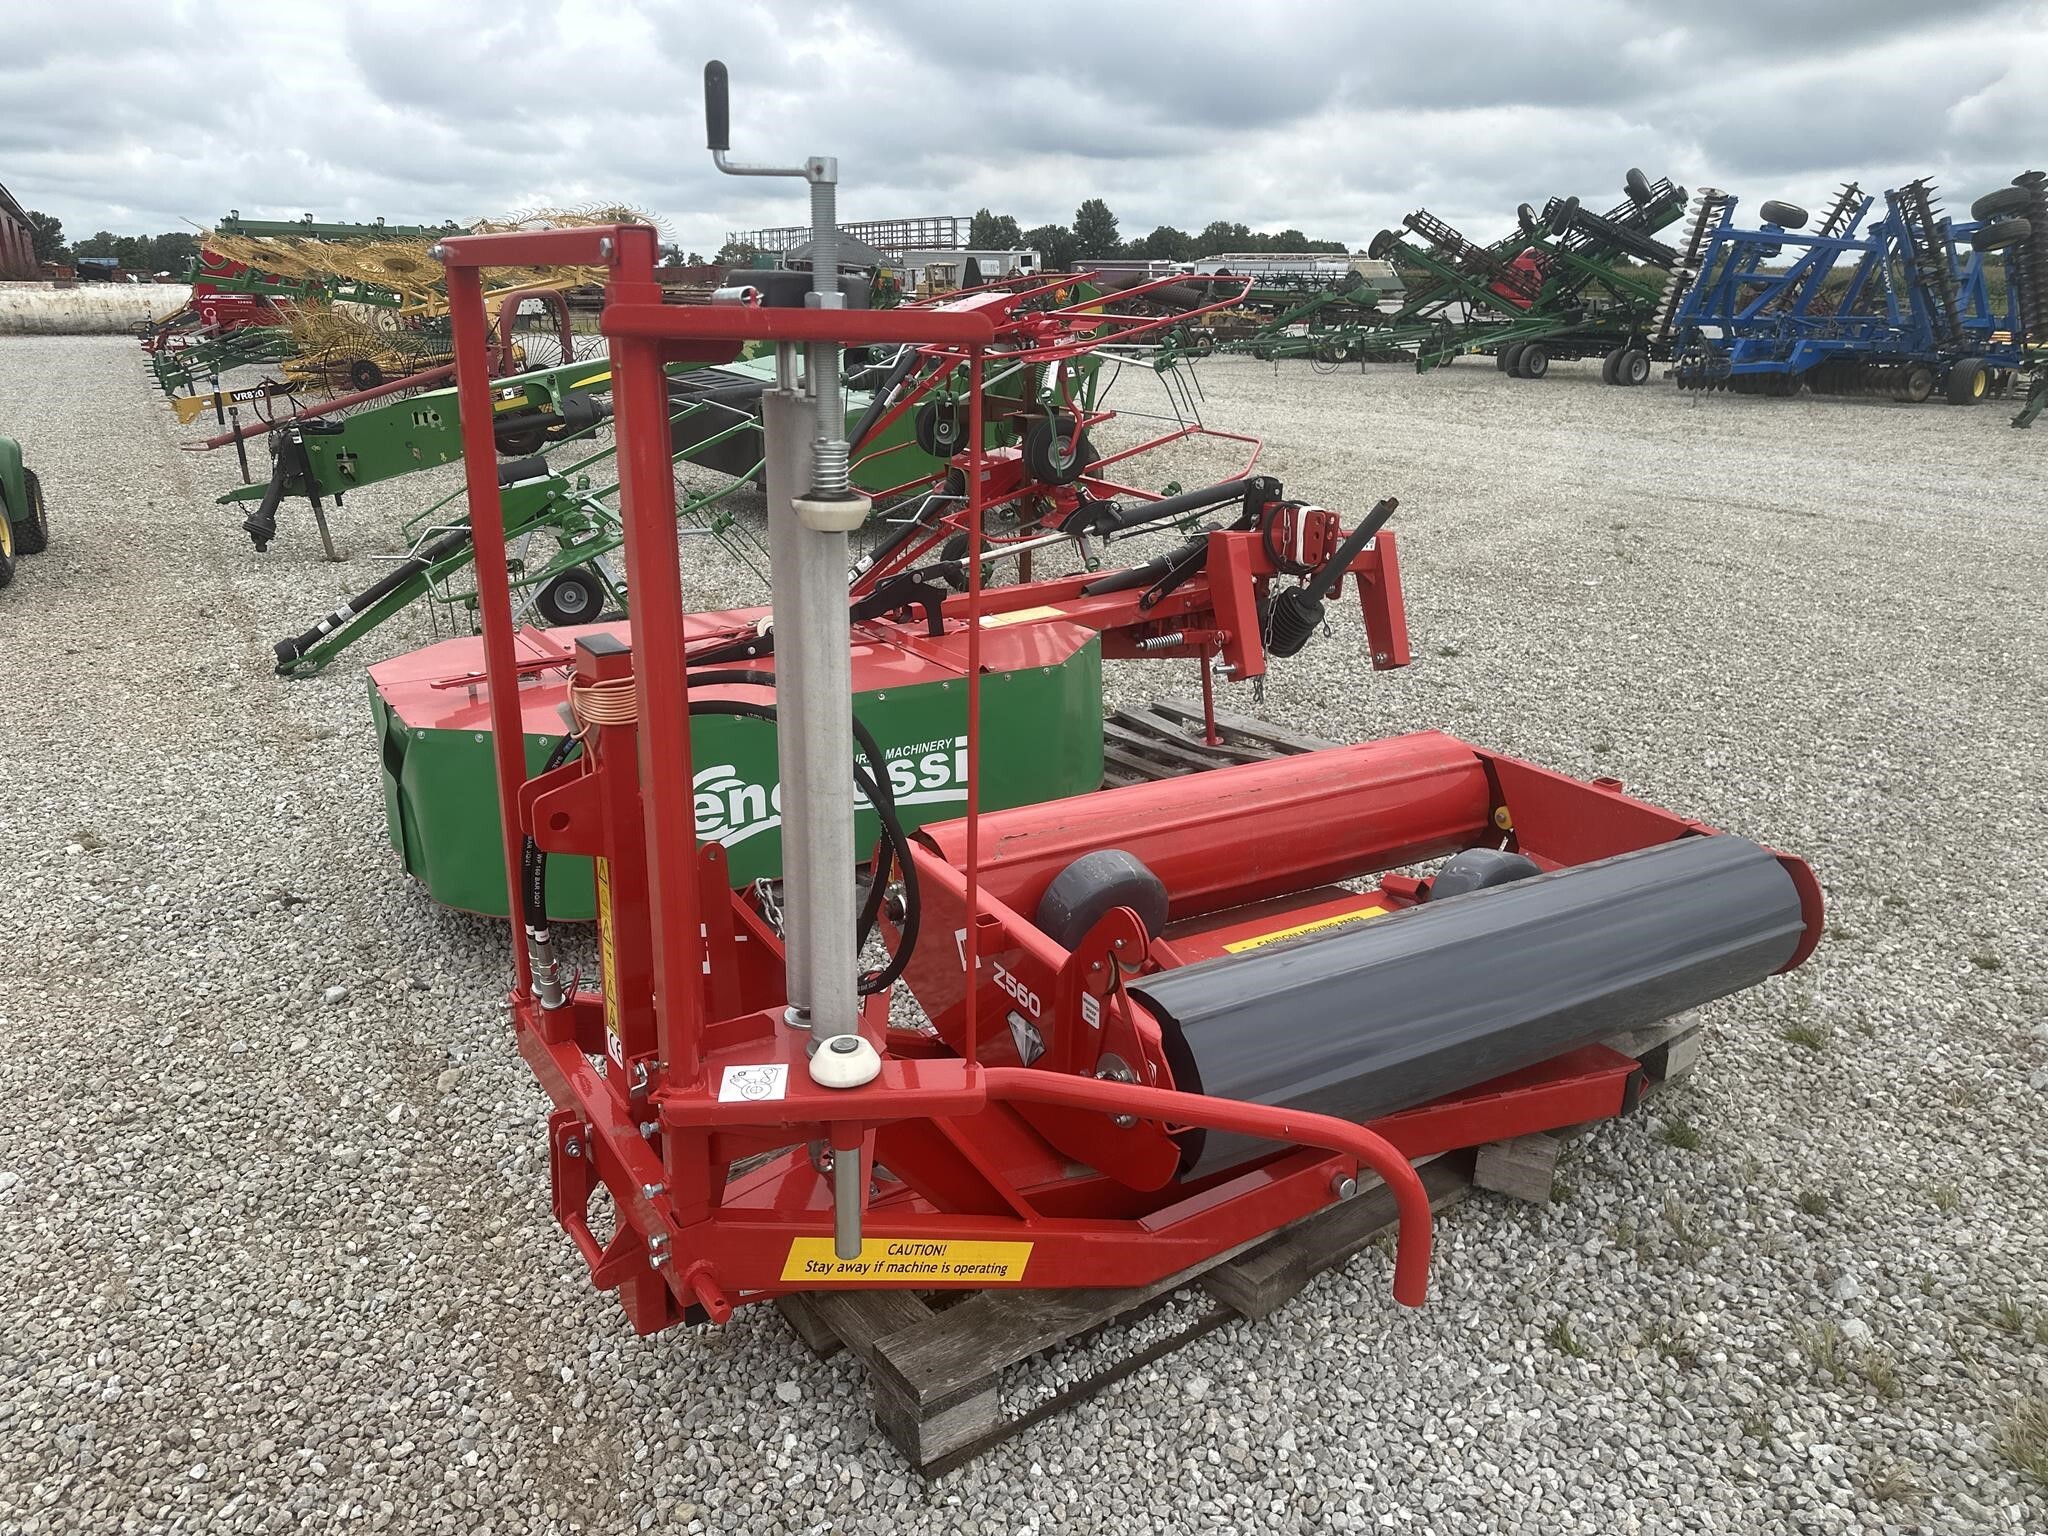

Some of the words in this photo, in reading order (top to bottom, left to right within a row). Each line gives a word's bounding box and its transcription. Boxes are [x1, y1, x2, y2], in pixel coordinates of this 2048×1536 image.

[885, 738, 953, 760] MACHINERY
[993, 960, 1041, 1018] Z560
[609, 1032, 623, 1065] CE
[887, 1243, 947, 1257] CAUTION!
[805, 1260, 834, 1275] Stay
[836, 1261, 871, 1275] away
[873, 1260, 884, 1274] if
[886, 1260, 938, 1274] machine
[941, 1261, 950, 1274] is
[953, 1261, 1008, 1277] operating
